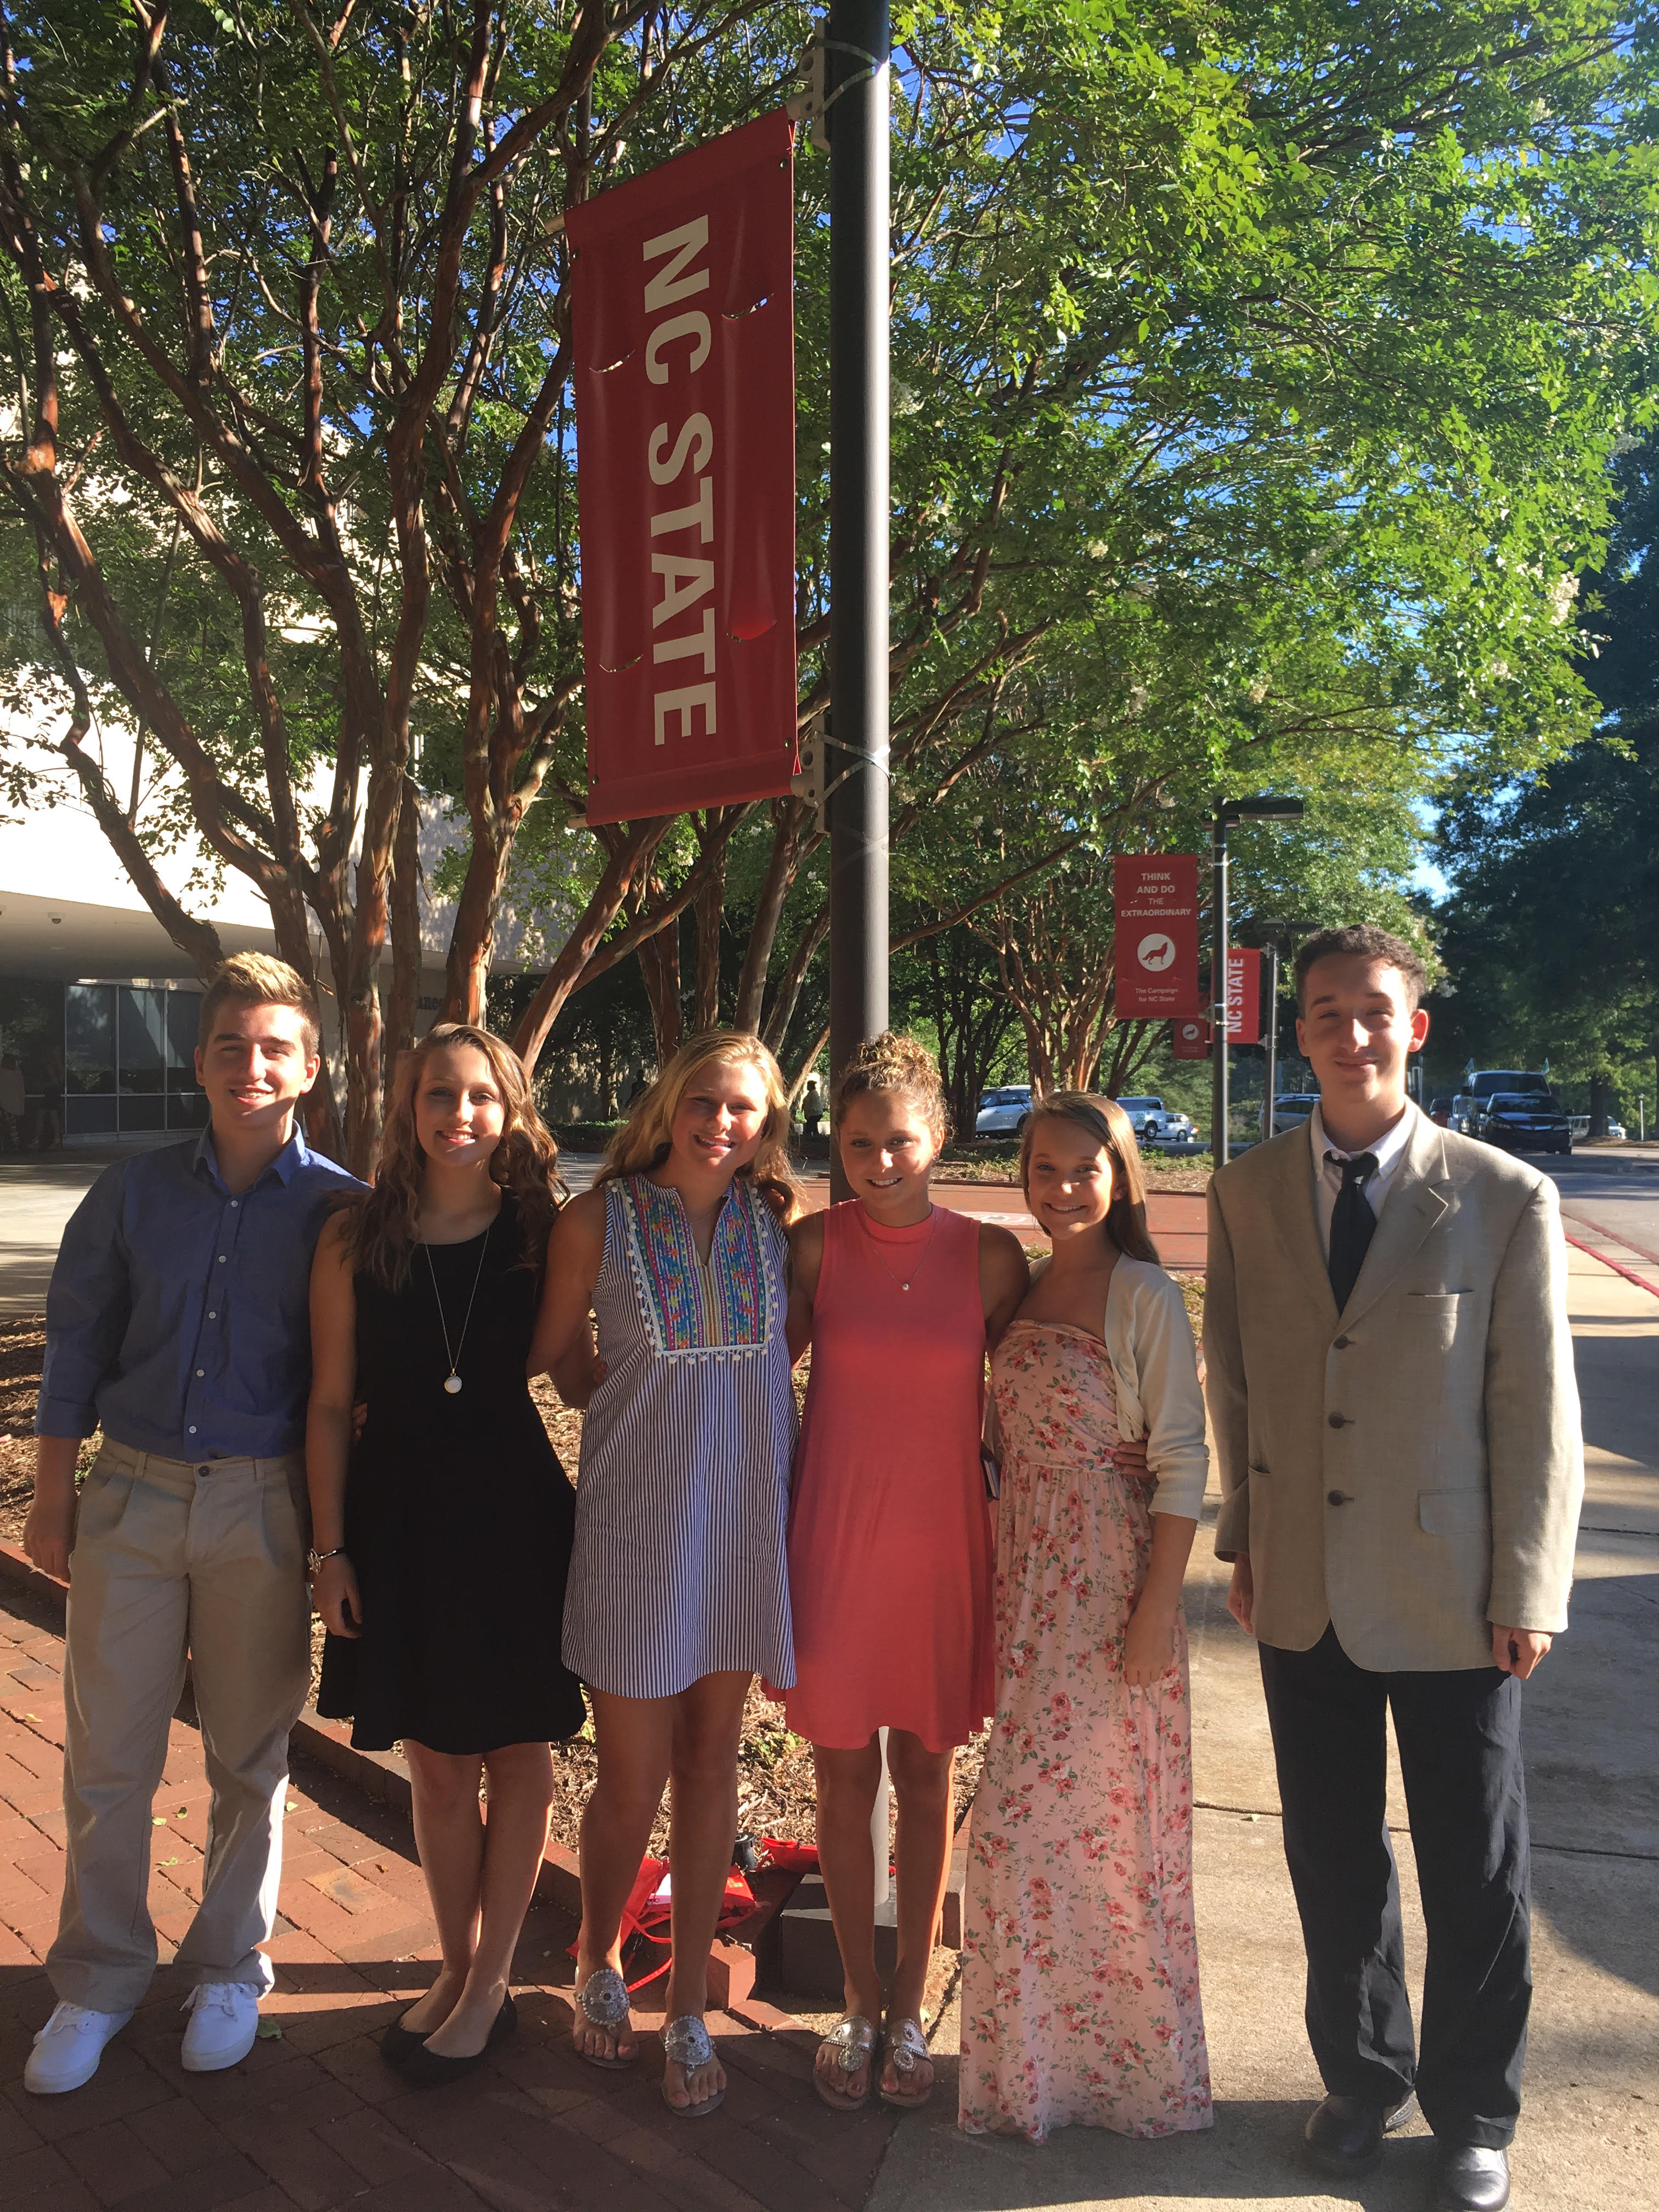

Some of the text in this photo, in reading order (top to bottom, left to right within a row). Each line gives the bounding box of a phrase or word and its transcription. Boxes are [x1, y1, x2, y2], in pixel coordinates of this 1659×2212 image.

[643, 214, 716, 746] NC STATE
[1136, 885, 1175, 894] AND DO
[1121, 909, 1191, 917] EXTRAORDINARY
[1226, 958, 1244, 1033] NC STATE
